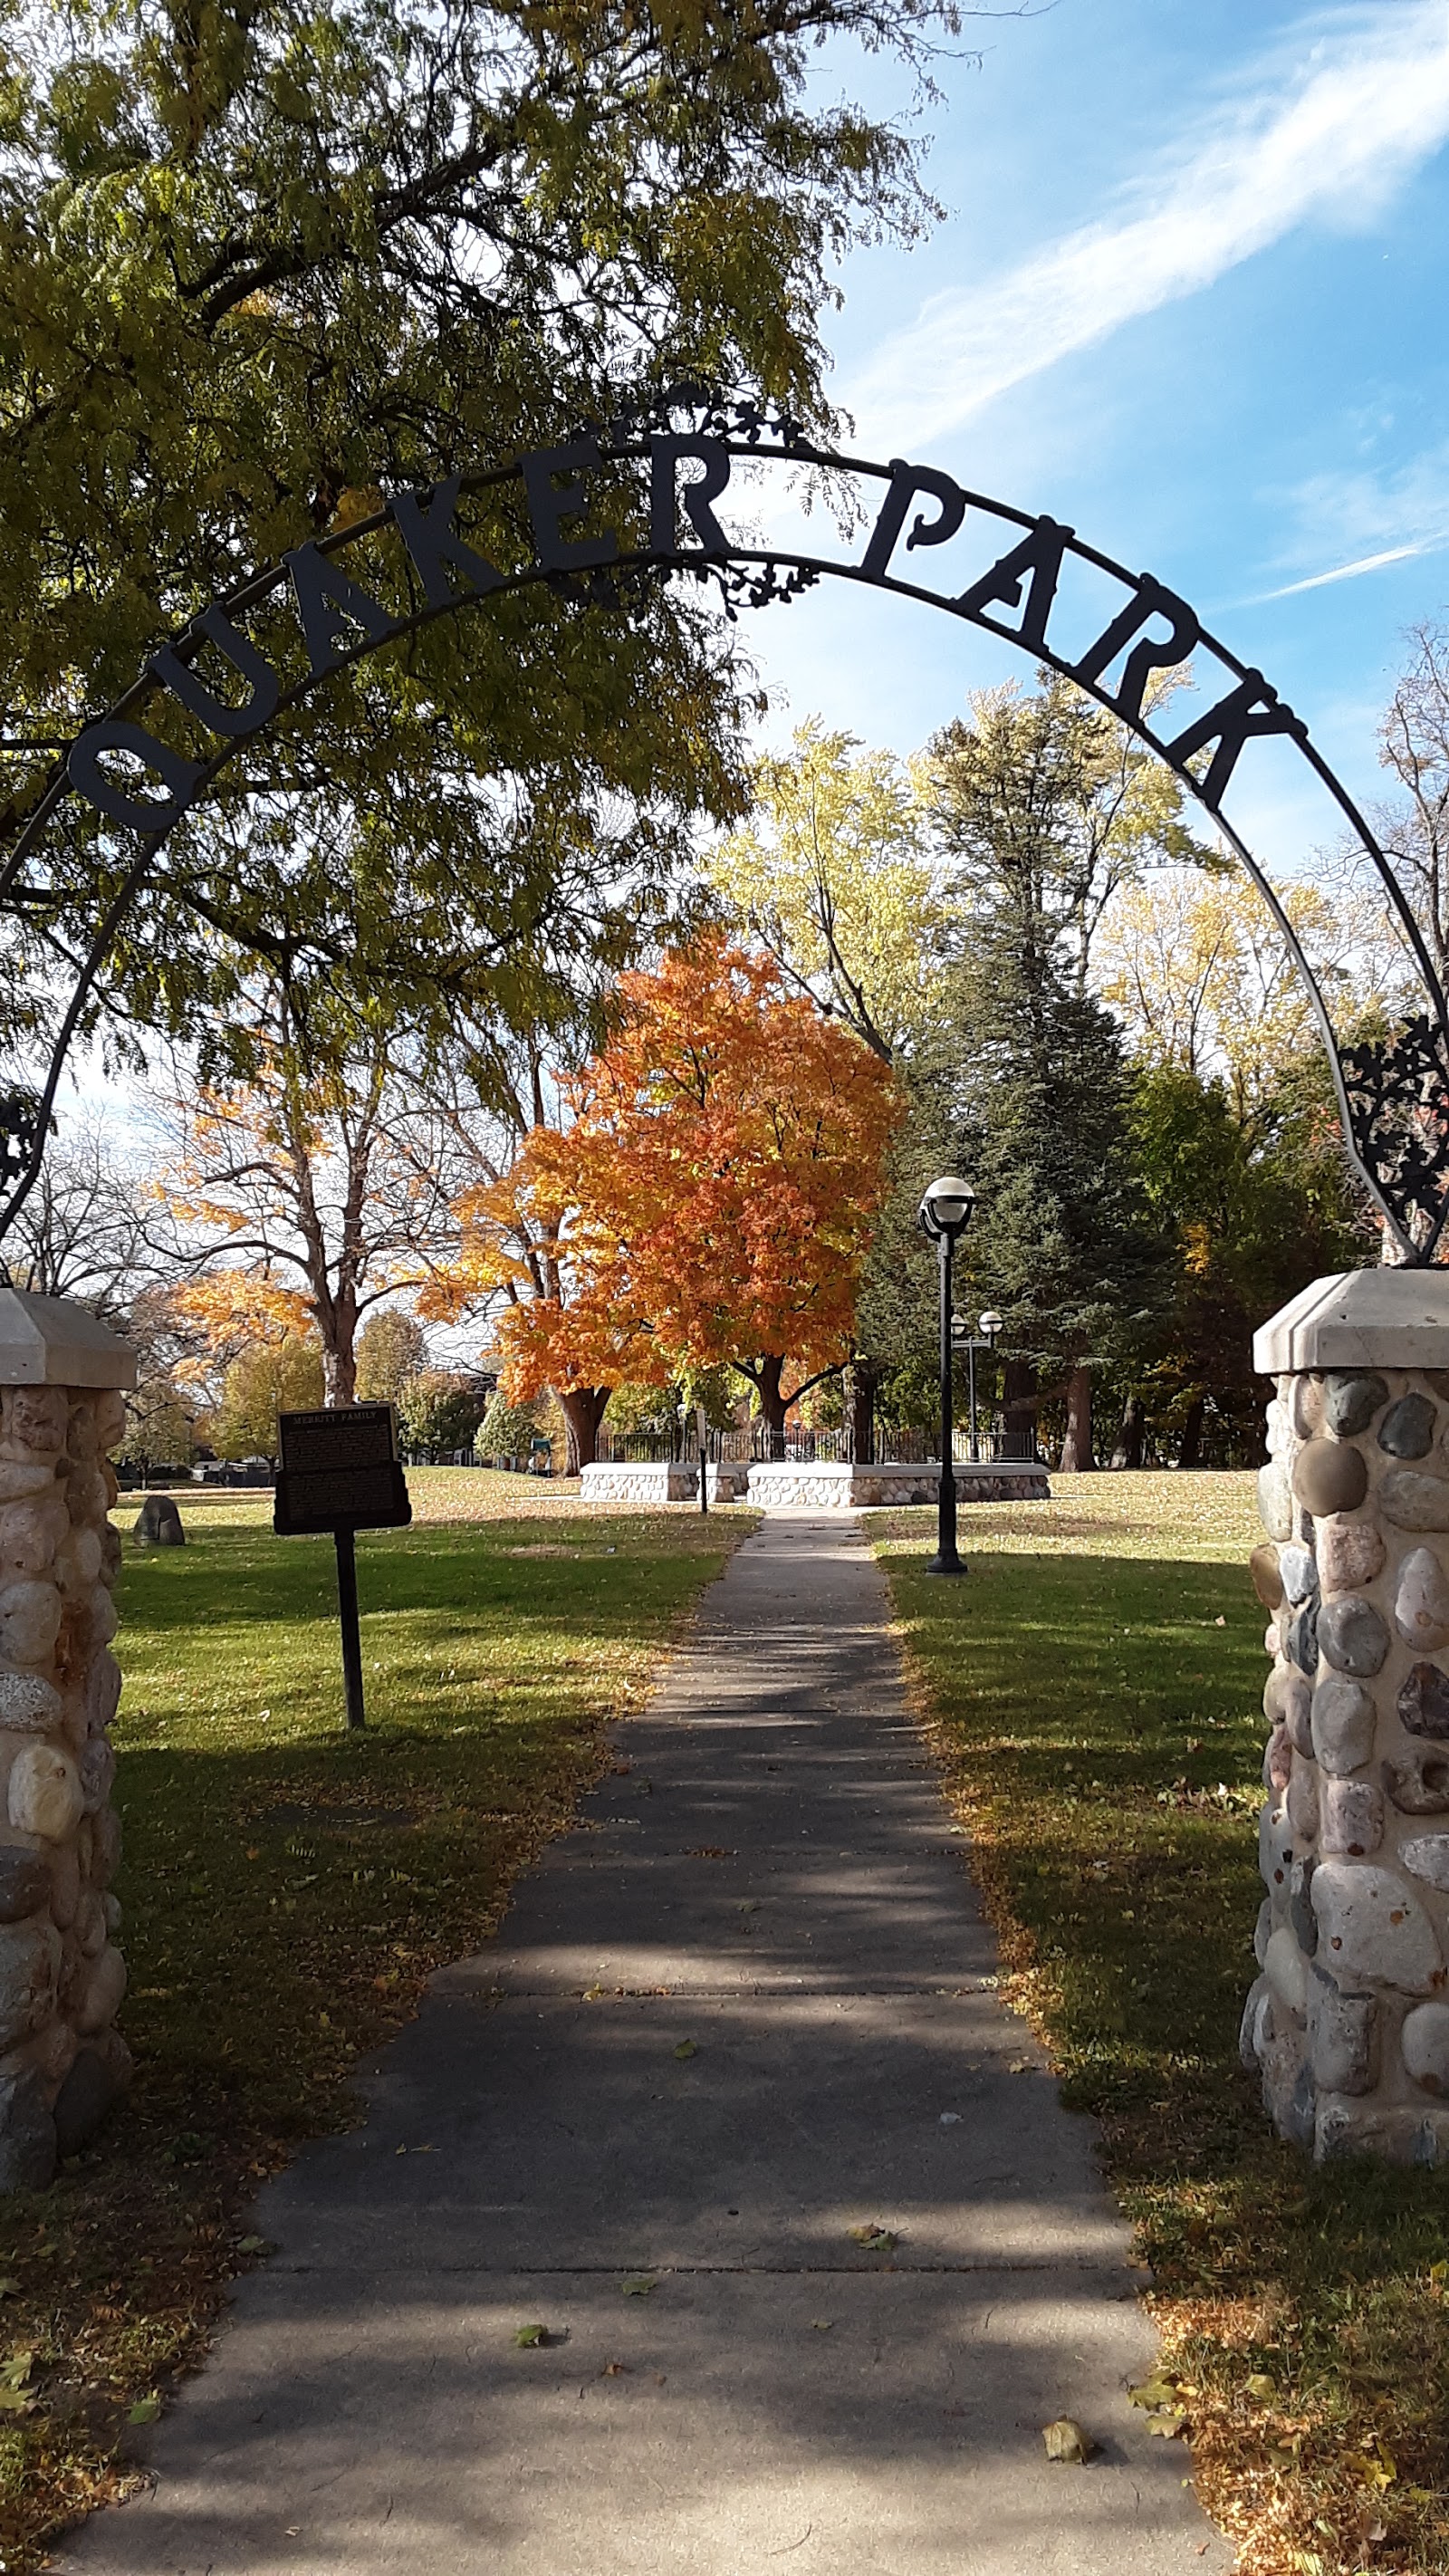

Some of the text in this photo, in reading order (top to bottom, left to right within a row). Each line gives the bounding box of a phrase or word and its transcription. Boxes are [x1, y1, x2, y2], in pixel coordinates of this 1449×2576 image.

[67, 435, 1307, 832] QUAKER PARK
[294, 1412, 377, 1425] MERRITT FAMILY
